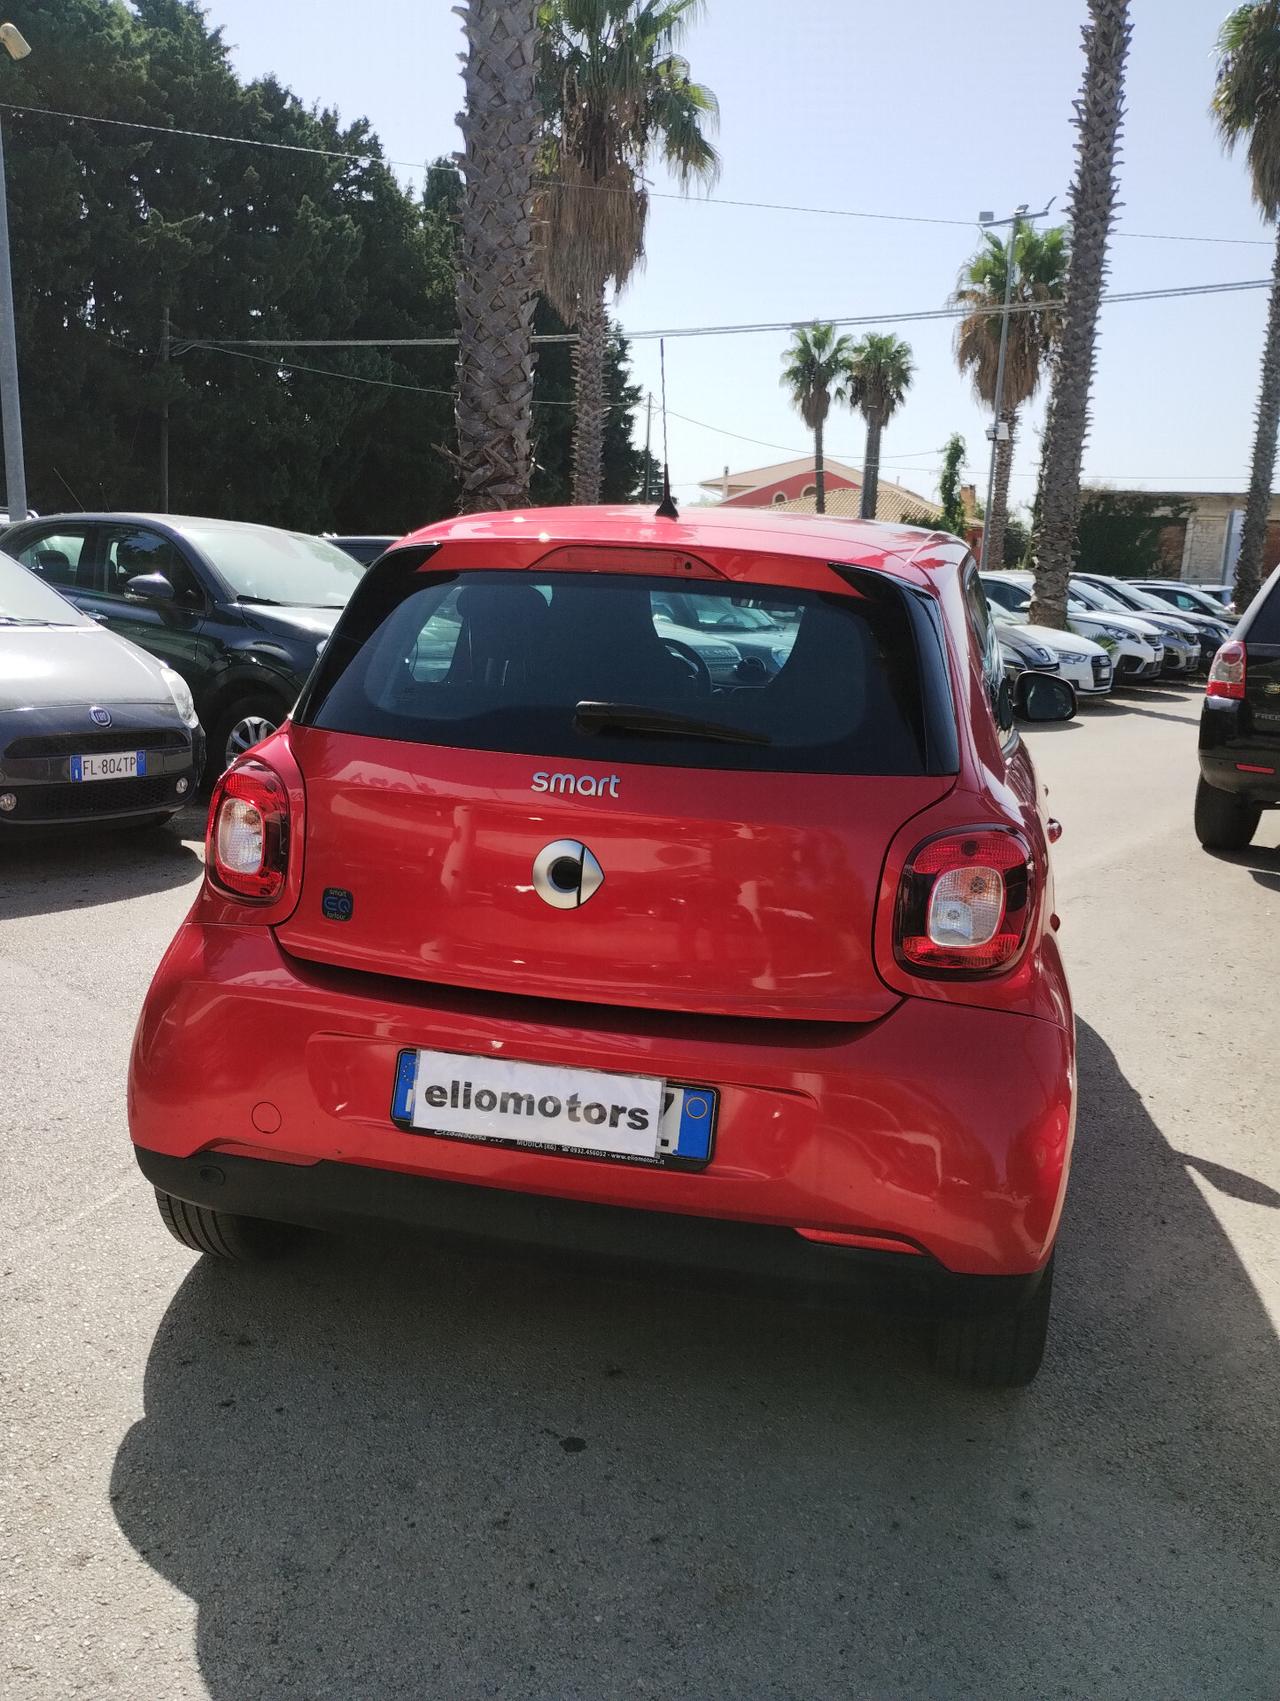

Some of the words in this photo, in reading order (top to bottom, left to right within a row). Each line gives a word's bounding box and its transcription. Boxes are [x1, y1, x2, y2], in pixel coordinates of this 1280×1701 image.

[530, 771, 621, 798] smart
[324, 896, 351, 912] EQ
[424, 1080, 650, 1131] eliomotors
